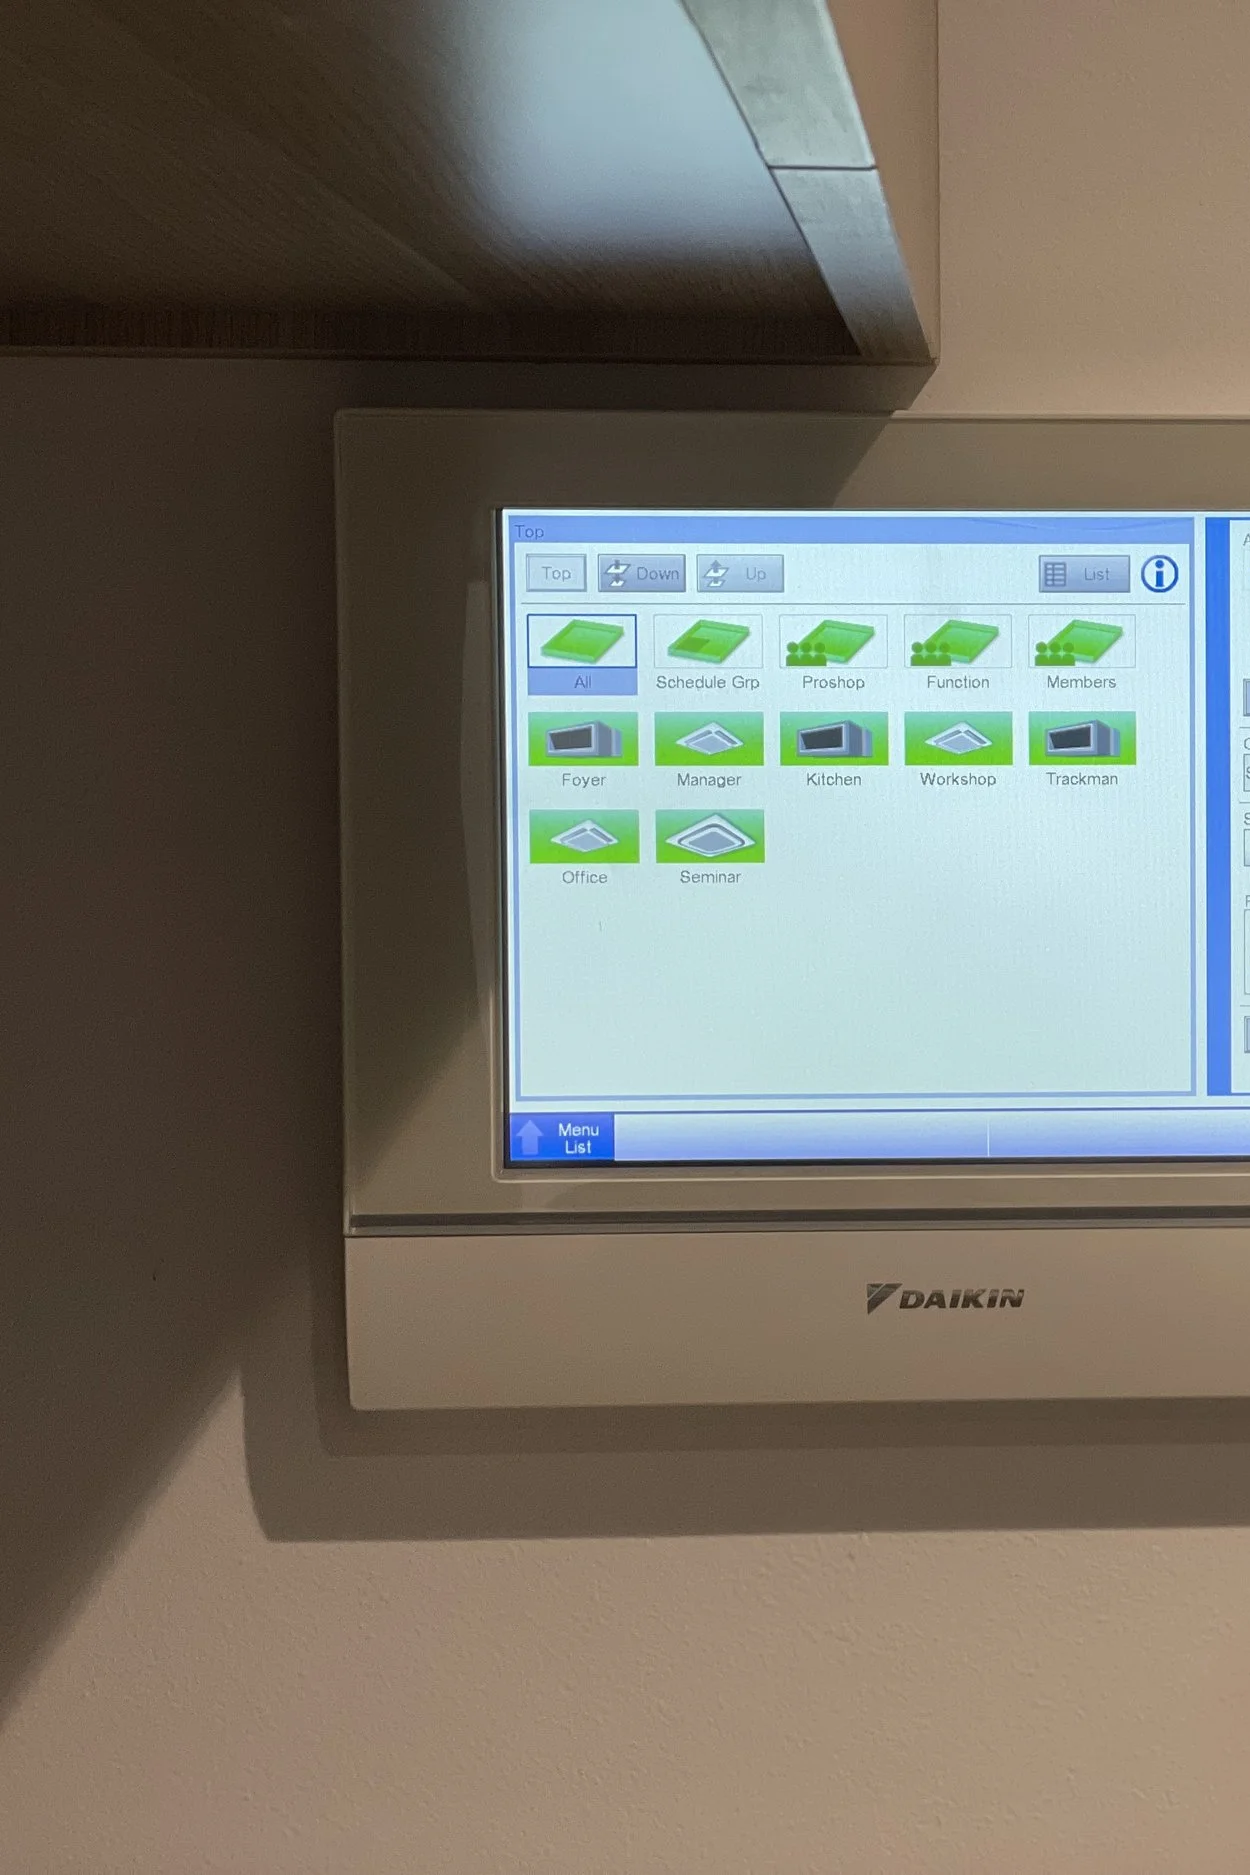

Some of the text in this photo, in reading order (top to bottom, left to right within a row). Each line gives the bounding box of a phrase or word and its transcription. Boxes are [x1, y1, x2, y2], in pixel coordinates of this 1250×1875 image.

[515, 524, 545, 540] Top
[542, 566, 571, 582] Top
[637, 566, 680, 581] Down
[746, 567, 766, 582] Up
[1084, 567, 1110, 581] List
[573, 676, 592, 689] All
[655, 675, 760, 692] Schedule Grp
[802, 675, 866, 691] Proshop
[927, 675, 990, 689] Function
[1047, 675, 1117, 689] Members
[562, 773, 607, 788] Foyer
[677, 773, 742, 788] Manager
[806, 773, 862, 786] Kitchen
[920, 772, 997, 788] Workshop
[1046, 772, 1119, 786] Trackman
[562, 871, 608, 884] Office
[679, 871, 742, 884] Seminar
[558, 1123, 600, 1137] Menu
[565, 1139, 592, 1154] List
[899, 1288, 1025, 1310] DAIKIN
